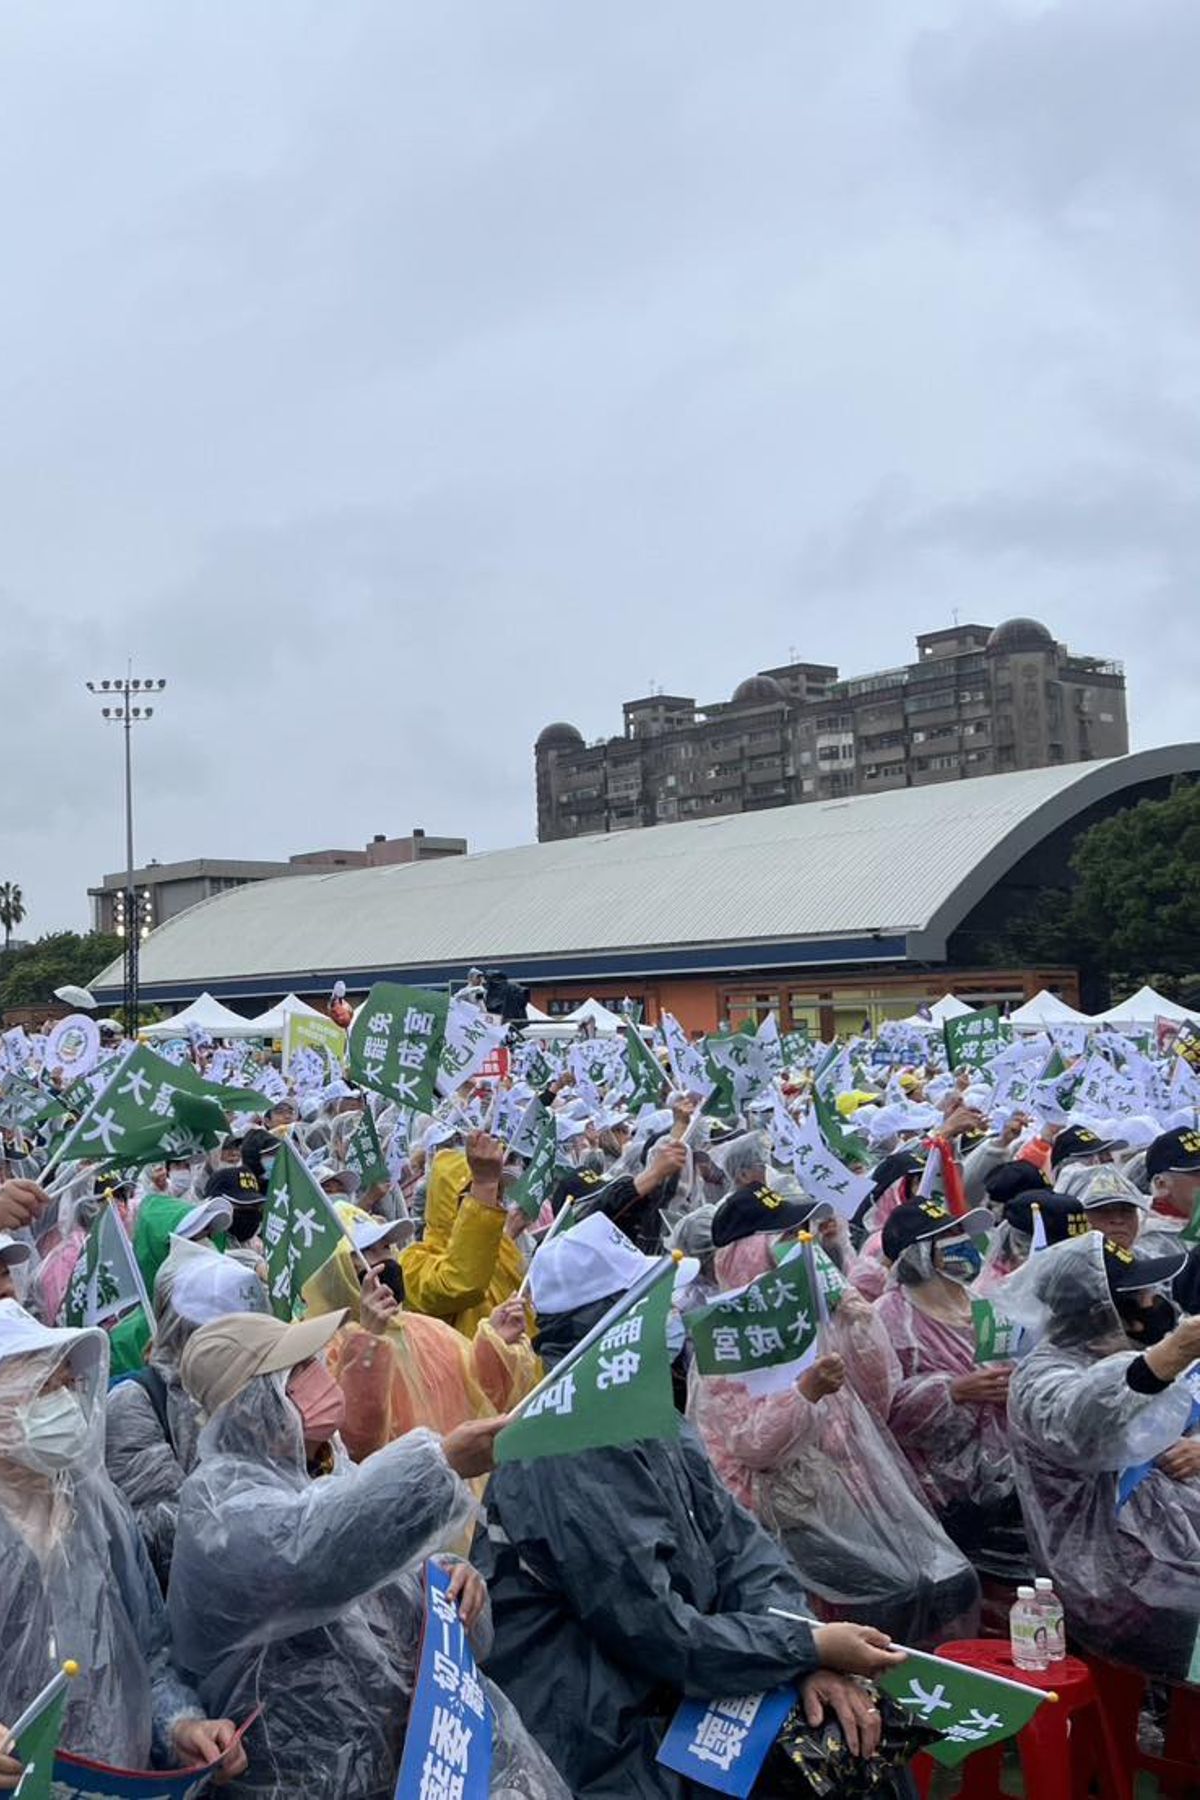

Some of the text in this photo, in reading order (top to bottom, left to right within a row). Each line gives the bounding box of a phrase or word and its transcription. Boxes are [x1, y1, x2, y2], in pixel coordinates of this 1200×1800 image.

[363, 1012, 393, 1085] 大罷免
[392, 1007, 435, 1101] 大成宮
[954, 1018, 995, 1037] 大罷免
[598, 1297, 649, 1390] 罷免
